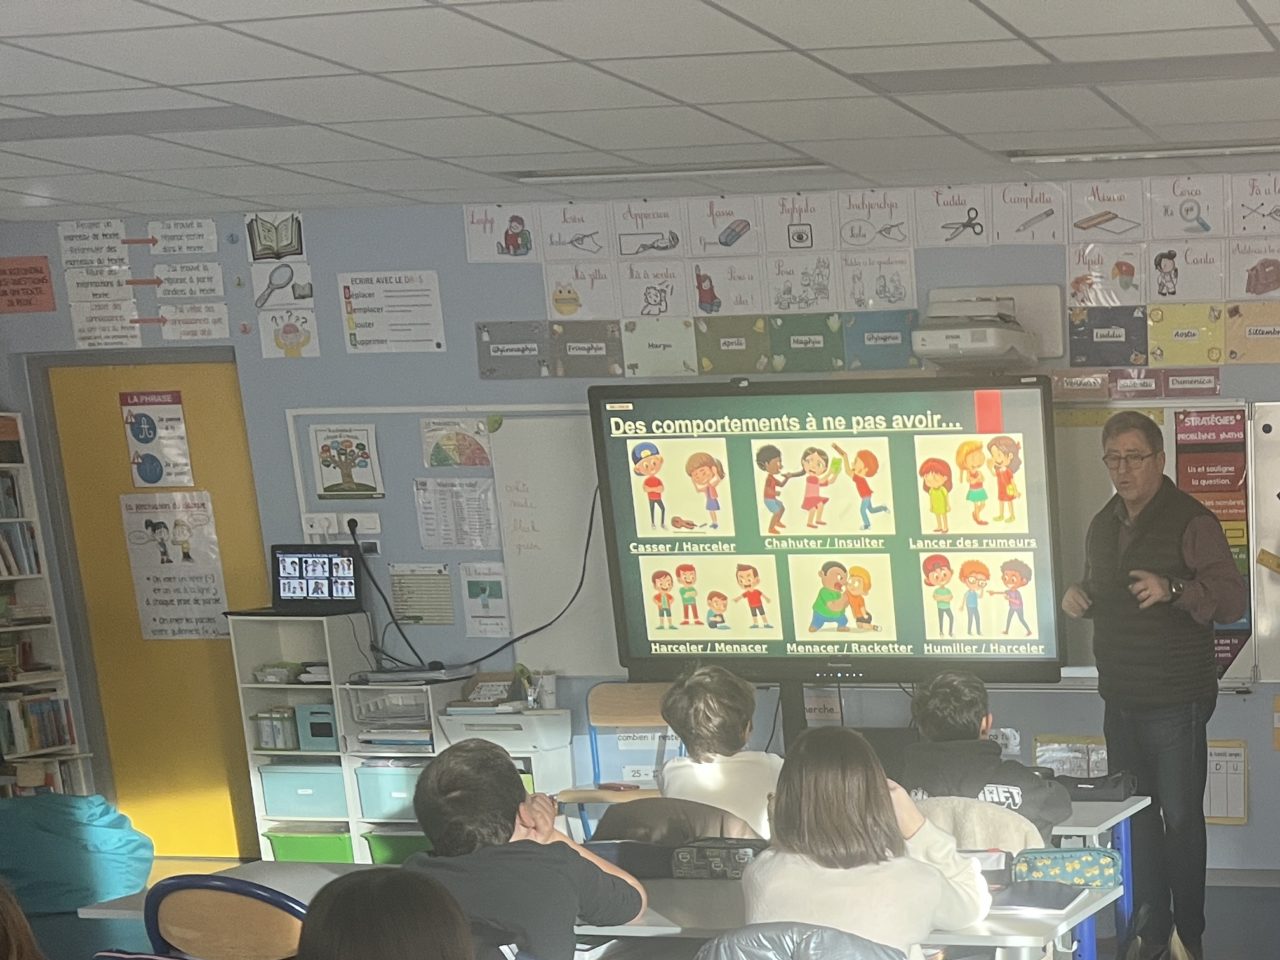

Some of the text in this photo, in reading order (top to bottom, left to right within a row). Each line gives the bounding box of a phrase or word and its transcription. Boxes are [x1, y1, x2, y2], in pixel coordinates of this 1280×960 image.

[1171, 377, 1212, 386] Dumenica
[610, 410, 961, 437] Des comportements à ne pas avoir...
[1184, 414, 1236, 427] STRATÉGIES
[1206, 464, 1235, 474] souligne
[1192, 477, 1232, 487] la question.
[629, 541, 671, 553] Casser
[683, 540, 736, 552] Harceler
[765, 537, 823, 549] Chahuter
[834, 536, 885, 548] Insulter
[909, 537, 1037, 548] Lancer des rumeurs
[651, 642, 704, 654] Harceler
[713, 641, 769, 653] Menacer
[786, 642, 840, 653] Menacer
[851, 642, 913, 654] Racketter
[987, 643, 1044, 654] Harceler
[617, 733, 648, 741] combien
[1215, 762, 1239, 772] D U
[631, 769, 641, 778] 25
